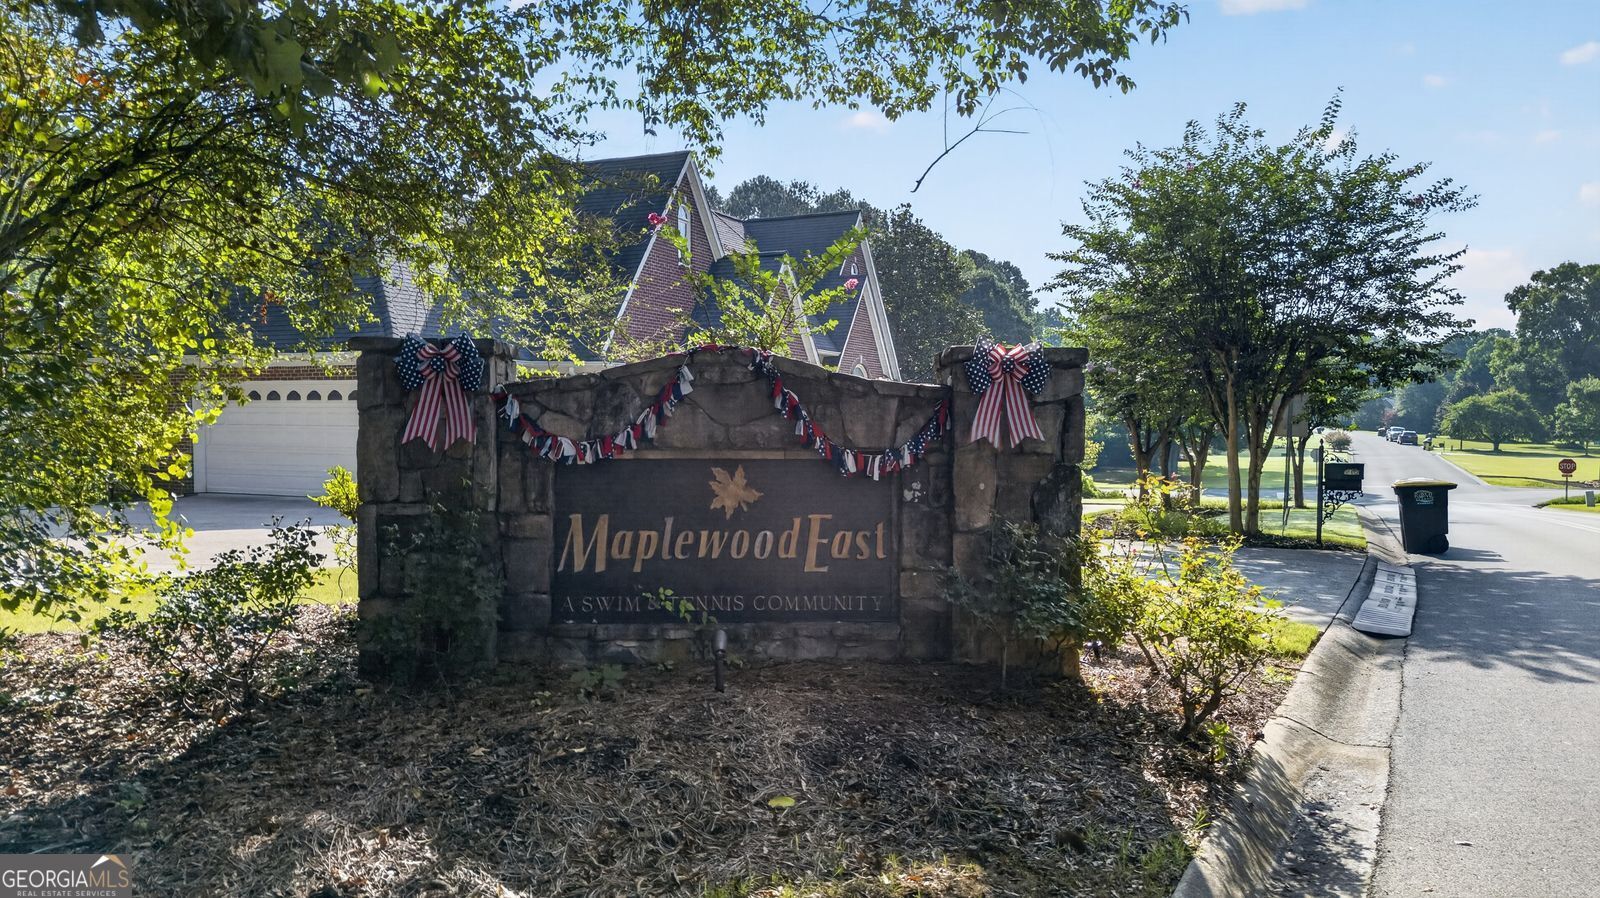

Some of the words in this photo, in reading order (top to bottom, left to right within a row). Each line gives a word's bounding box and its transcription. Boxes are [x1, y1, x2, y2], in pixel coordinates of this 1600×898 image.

[561, 597, 575, 612] A
[582, 597, 641, 612] SWIM
[753, 596, 884, 612] COMMUNITY
